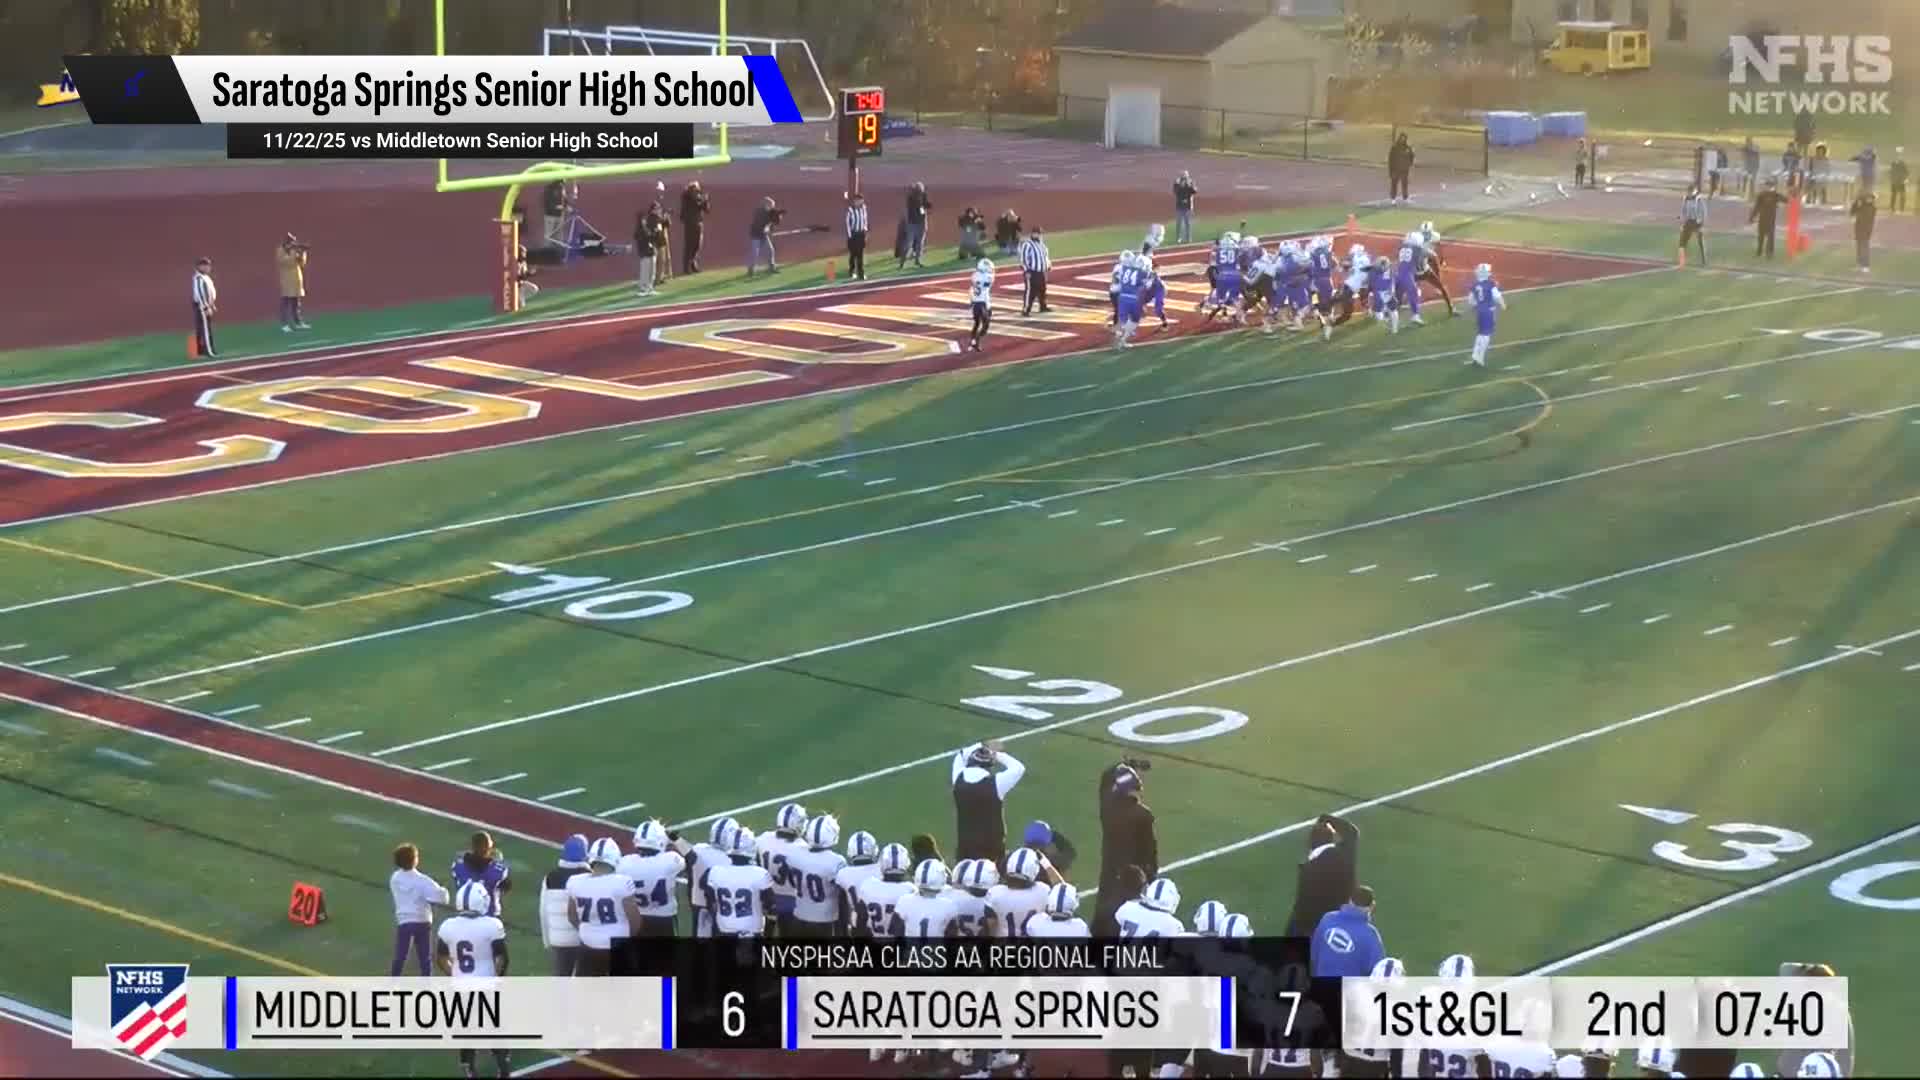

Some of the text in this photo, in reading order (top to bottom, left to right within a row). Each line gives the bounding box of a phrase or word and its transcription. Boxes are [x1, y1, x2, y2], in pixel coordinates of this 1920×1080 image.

[859, 113, 877, 143] 19
[1219, 249, 1236, 264] 50
[1122, 269, 1138, 285] 84
[489, 573, 695, 621] 10
[959, 678, 1250, 744] 20
[293, 887, 319, 917] 20
[635, 879, 667, 908] 54
[717, 887, 753, 918] 62
[577, 897, 618, 925] 78
[456, 940, 475, 974] 6
